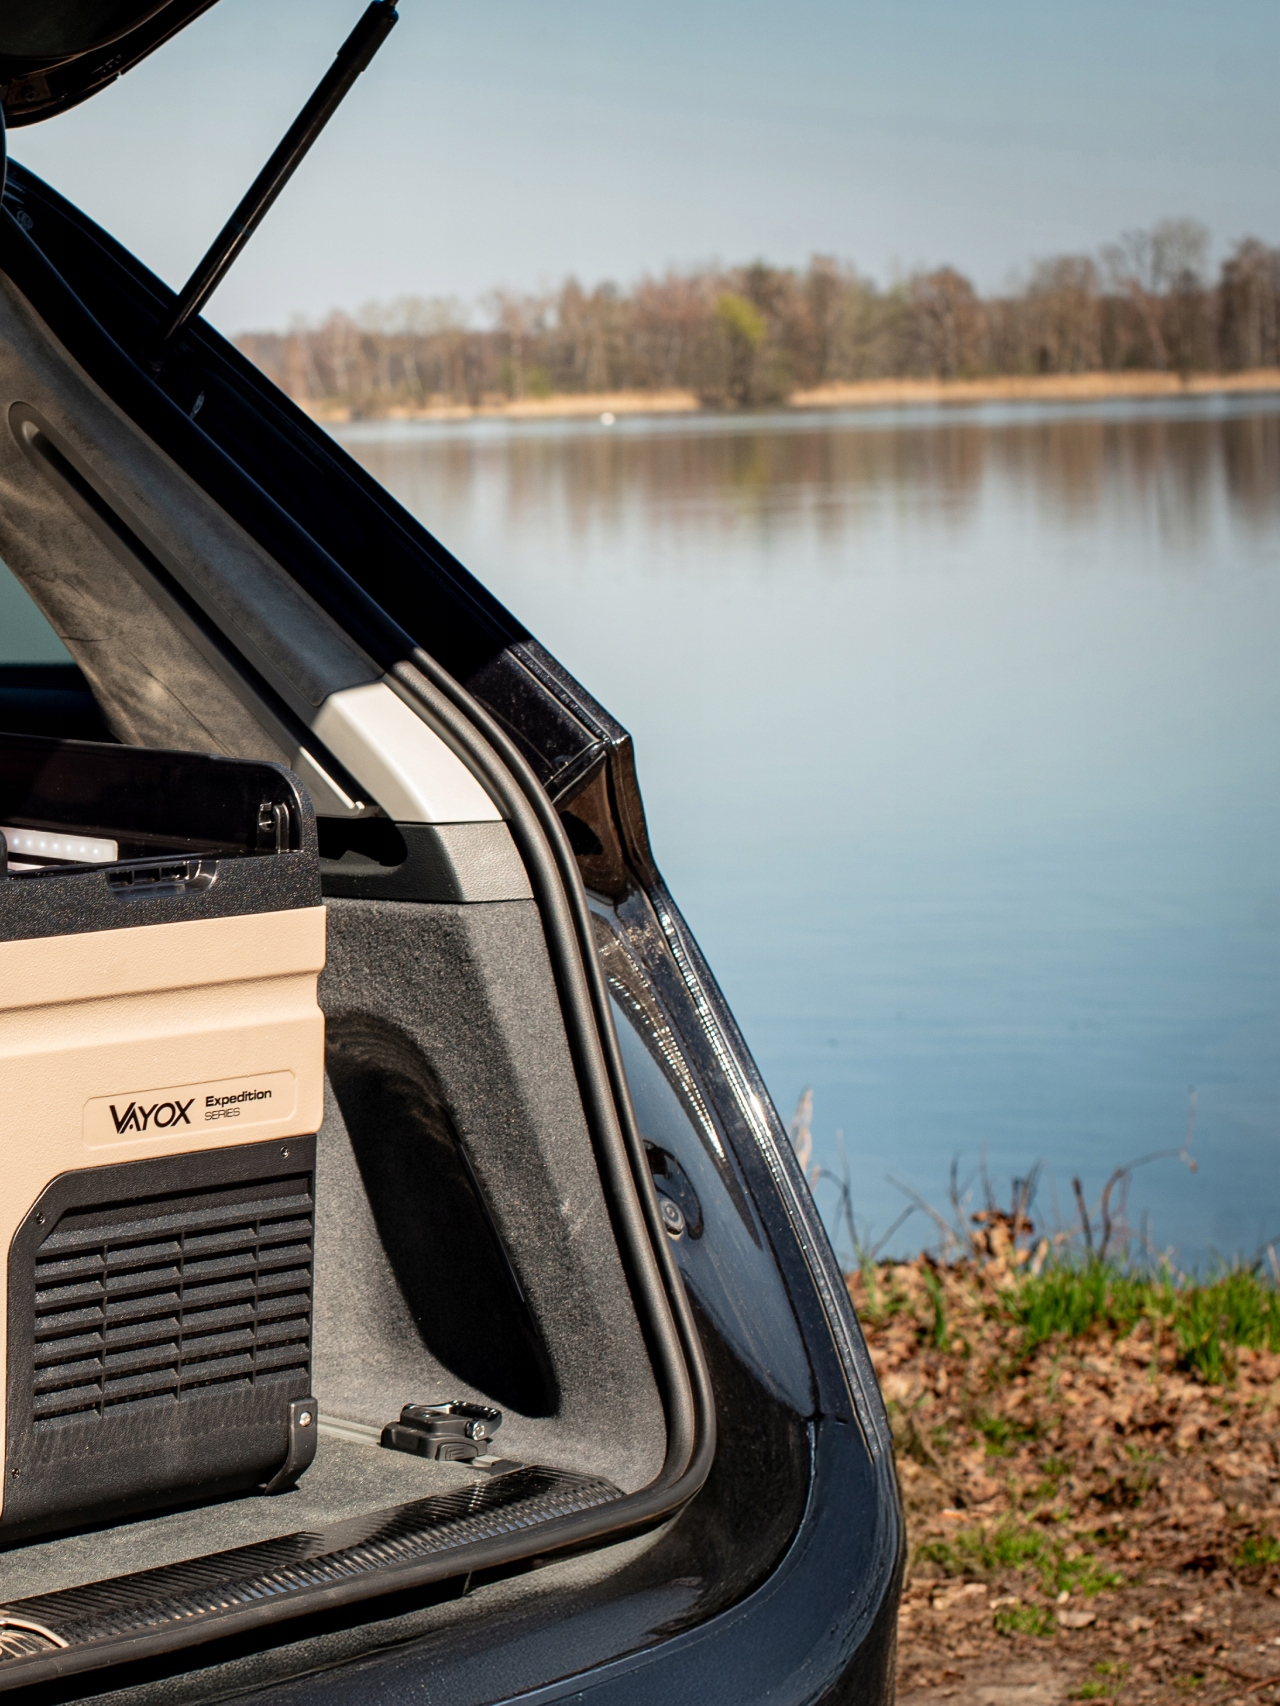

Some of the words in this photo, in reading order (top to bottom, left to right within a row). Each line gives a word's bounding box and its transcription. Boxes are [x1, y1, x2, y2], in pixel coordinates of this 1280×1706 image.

[205, 1088, 273, 1108] Expedition
[109, 1098, 196, 1134] VAYOX
[204, 1107, 241, 1121] SERIES
